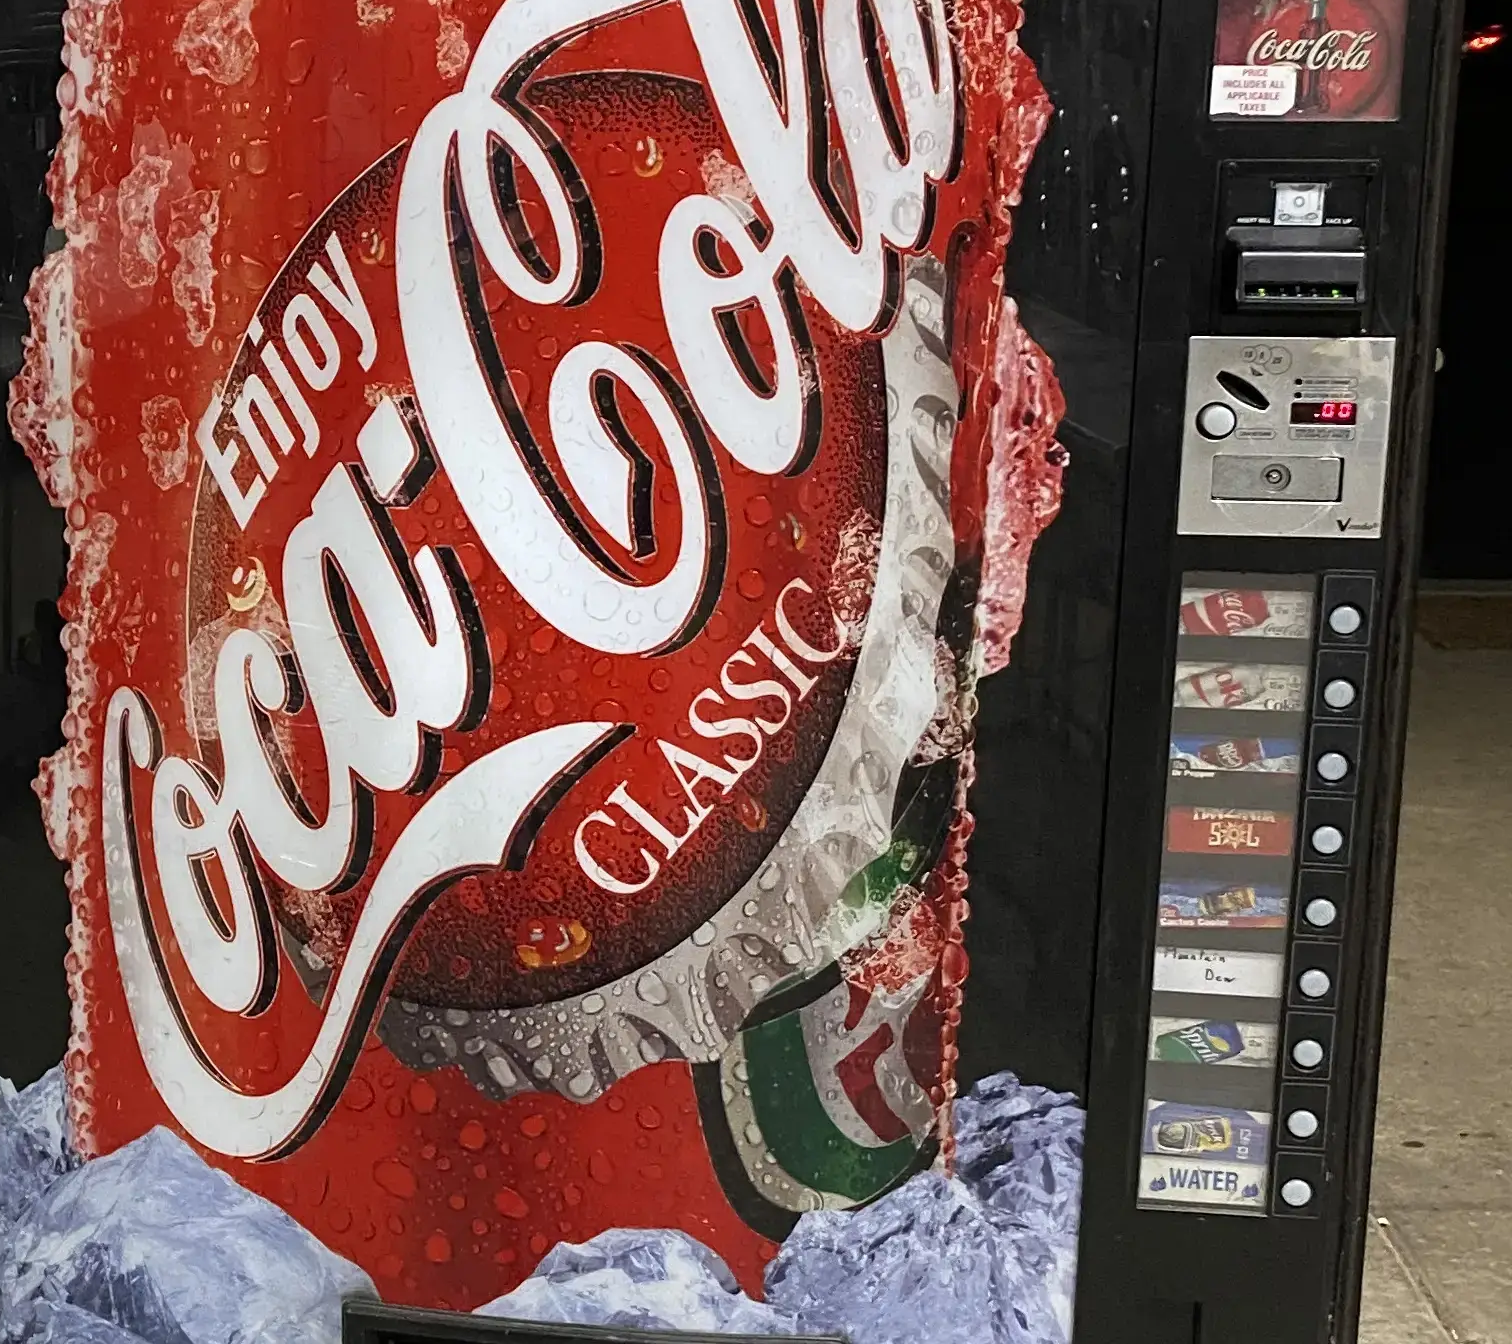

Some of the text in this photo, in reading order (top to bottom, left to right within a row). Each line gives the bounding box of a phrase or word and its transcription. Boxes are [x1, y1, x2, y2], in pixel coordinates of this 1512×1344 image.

[1246, 28, 1378, 72] Coca-Cola
[1242, 68, 1269, 77] PRICE
[1222, 79, 1285, 89] INCLUDES ALL
[1226, 91, 1281, 101] APPLICABLE
[1239, 103, 1266, 112] TAXES
[197, 231, 372, 532] Enjoy
[574, 575, 851, 899] CLASSIC
[1171, 769, 1215, 777] Dr Pepper
[1159, 918, 1229, 926] Cactus Cooler
[1163, 948, 1226, 963] Mountain
[1205, 968, 1236, 983] Dew
[1169, 1167, 1238, 1193] WATER
